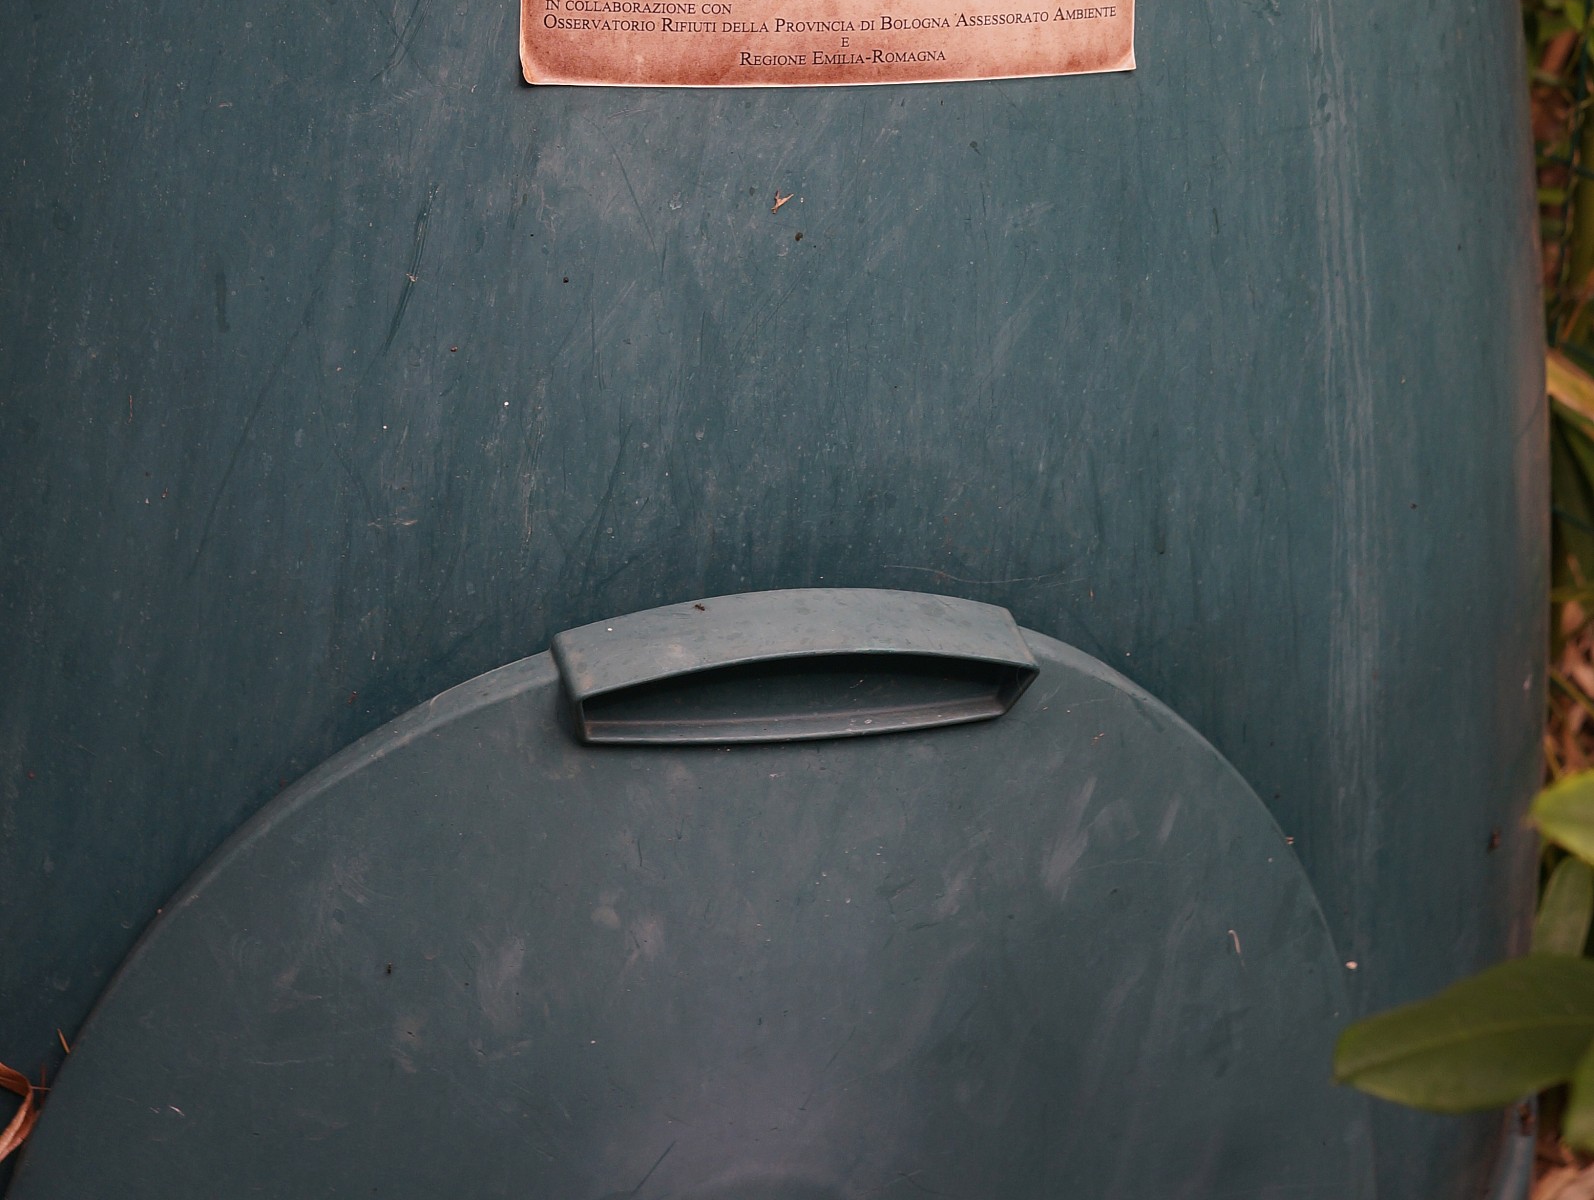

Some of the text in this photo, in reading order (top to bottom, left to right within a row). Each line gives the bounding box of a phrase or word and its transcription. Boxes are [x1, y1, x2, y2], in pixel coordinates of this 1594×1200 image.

[545, 0, 732, 15] IN COLLABORAZIONE CON
[543, 5, 1118, 34] OSSERVATORIO RIFIUTI DELLA PROVINCIA DI BOLOGNA ASSESSORATO AMBIENTE
[840, 36, 850, 48] E
[739, 49, 947, 67] REGIONE EMILIA-ROMAGNA
